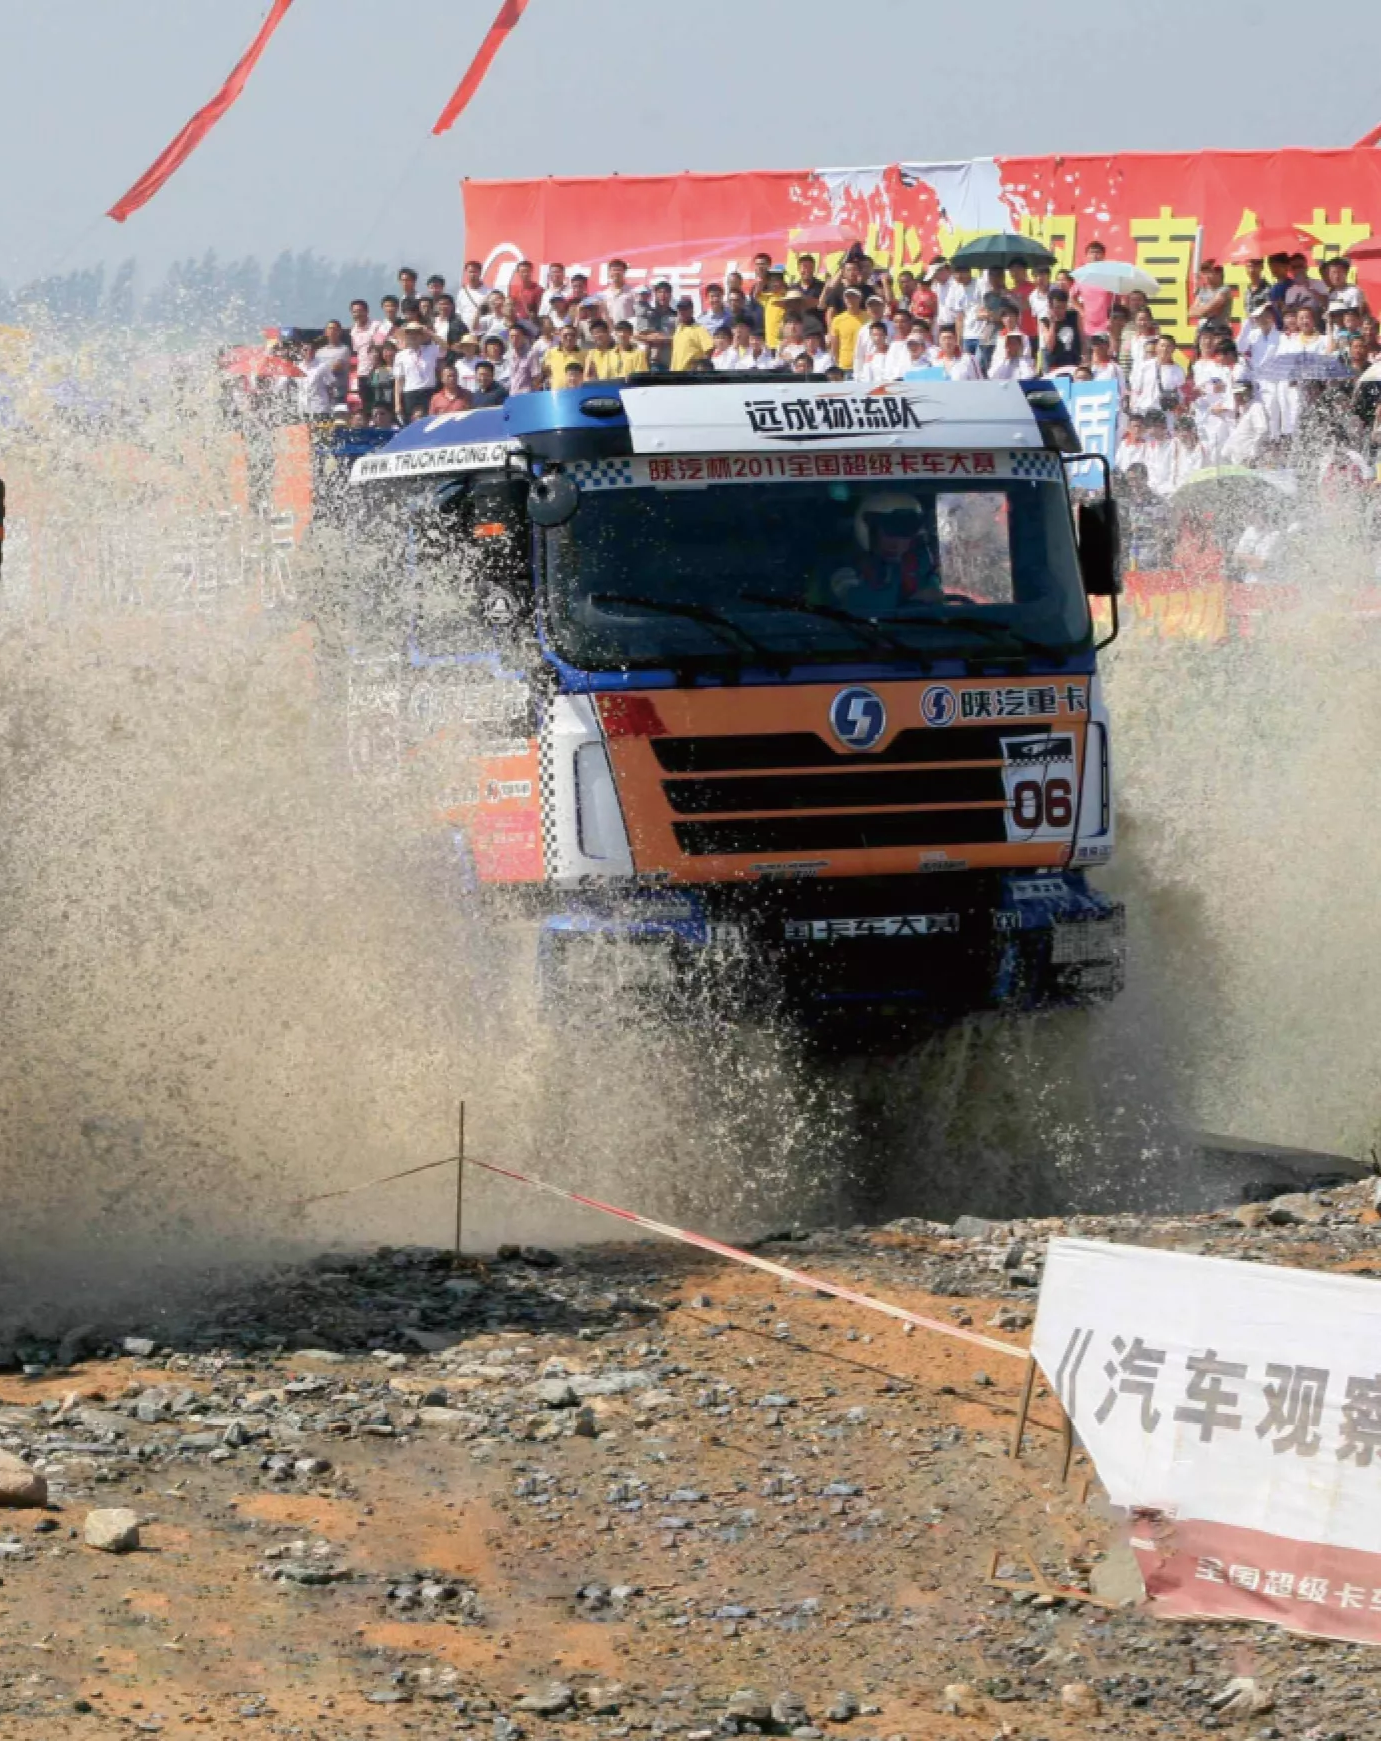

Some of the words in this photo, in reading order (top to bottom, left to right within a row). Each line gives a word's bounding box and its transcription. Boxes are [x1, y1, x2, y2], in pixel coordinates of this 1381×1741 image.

[745, 396, 922, 433] 远成物流队
[648, 451, 997, 481] 陕汽杯2011全国超级卡车大赛
[960, 684, 1087, 720] 陕汽重卡
[1013, 777, 1073, 830] 06
